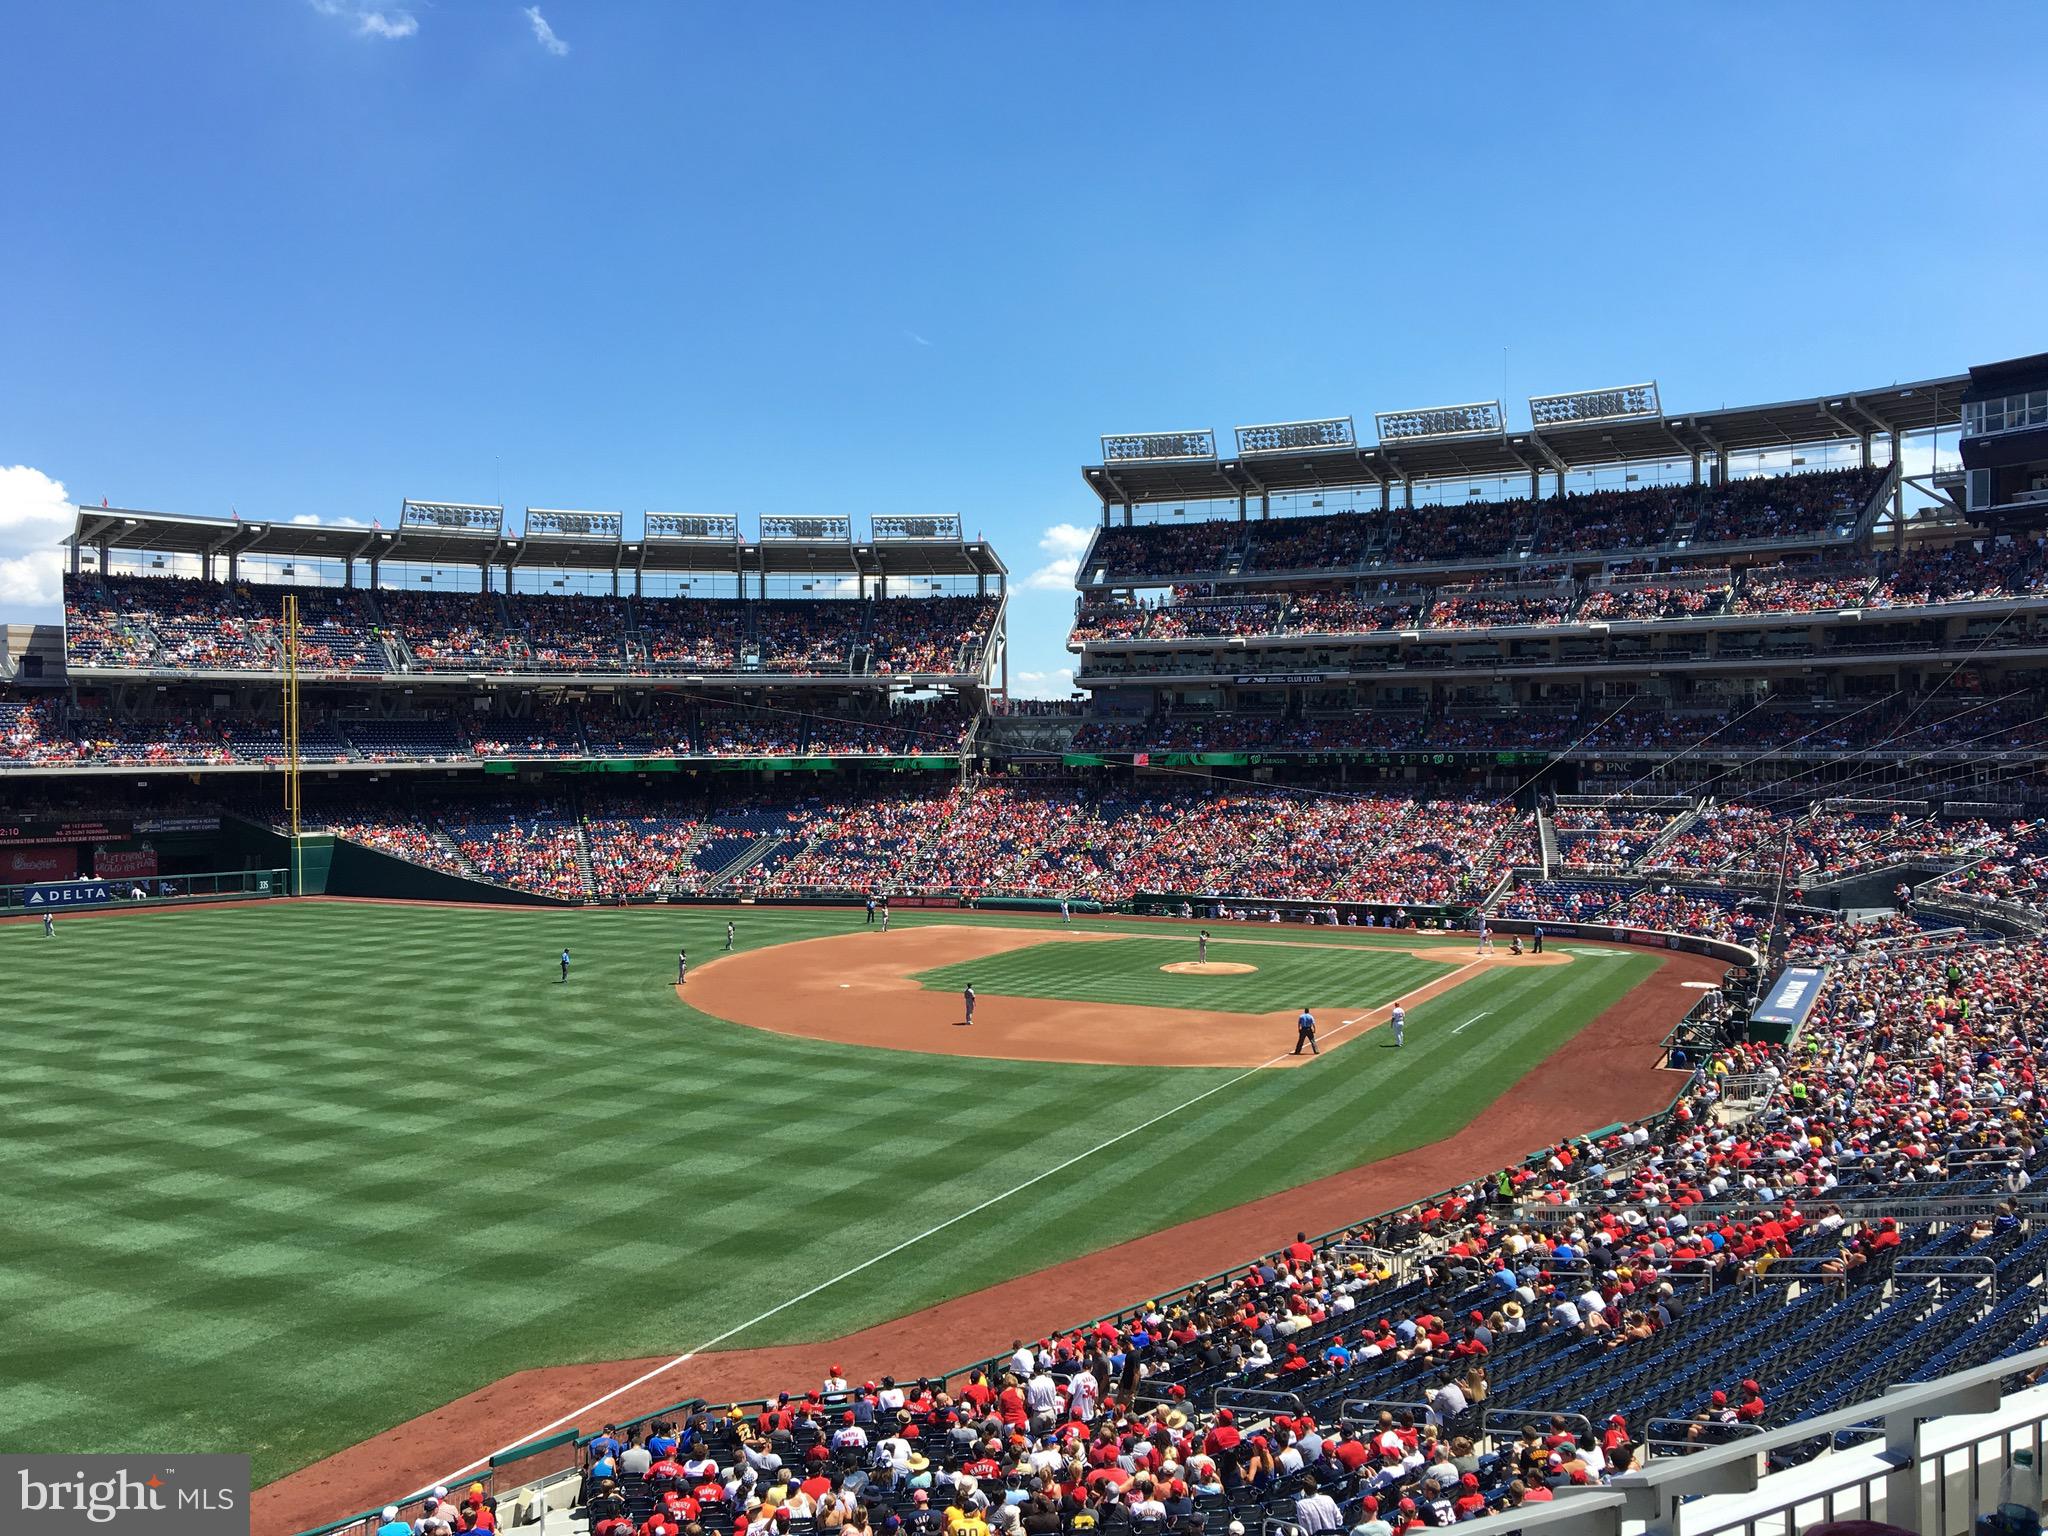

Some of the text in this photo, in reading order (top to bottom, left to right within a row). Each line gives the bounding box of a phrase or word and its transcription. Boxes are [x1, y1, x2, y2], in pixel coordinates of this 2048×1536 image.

[1606, 761, 1632, 772] PNC
[258, 880, 269, 890] 335
[49, 887, 106, 901] DELTA
[1081, 1385, 1096, 1399] 34
[970, 1464, 994, 1475] HARPER
[1435, 1507, 1456, 1527] 34
